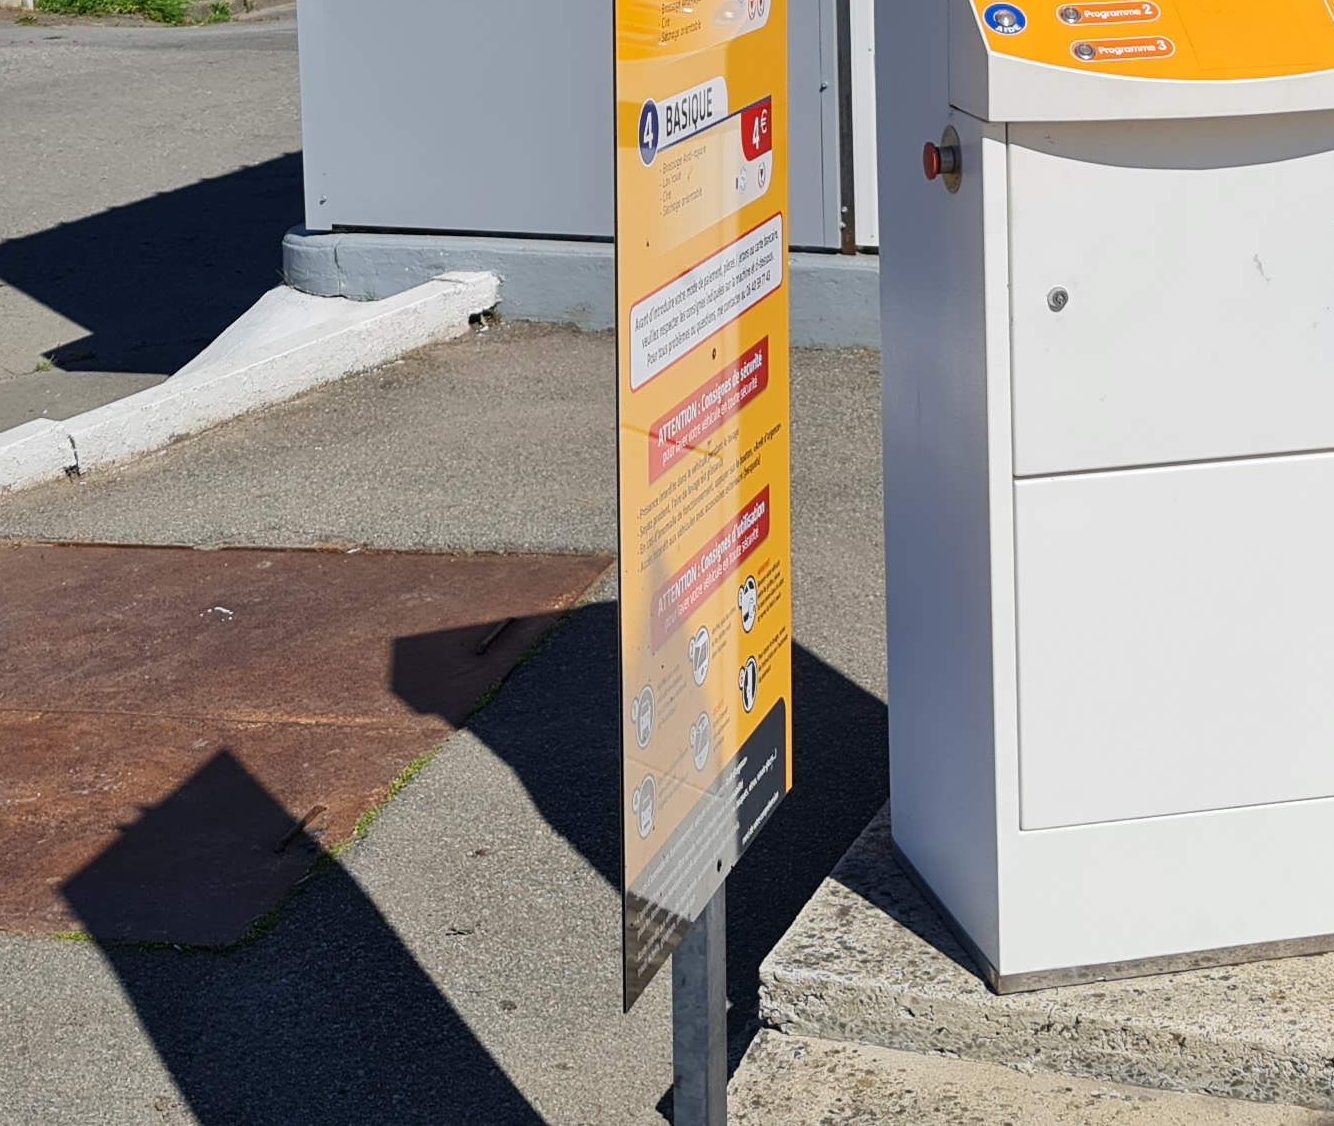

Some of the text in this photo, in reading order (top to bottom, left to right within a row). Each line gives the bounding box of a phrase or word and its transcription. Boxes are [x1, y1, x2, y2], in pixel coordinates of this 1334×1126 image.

[995, 24, 1022, 34] AIDE
[1084, 3, 1153, 19] Programme 2
[1098, 40, 1167, 55] Programme 3
[643, 86, 713, 149] 4 BASIQUE
[752, 109, 768, 150] 4€
[658, 351, 761, 446] ATTENTION Consignes de sécurité
[663, 445, 675, 466] pour
[689, 424, 701, 442] votre
[658, 502, 764, 614] ATTENTION Consignes d'utilisation
[690, 584, 702, 603] votre
